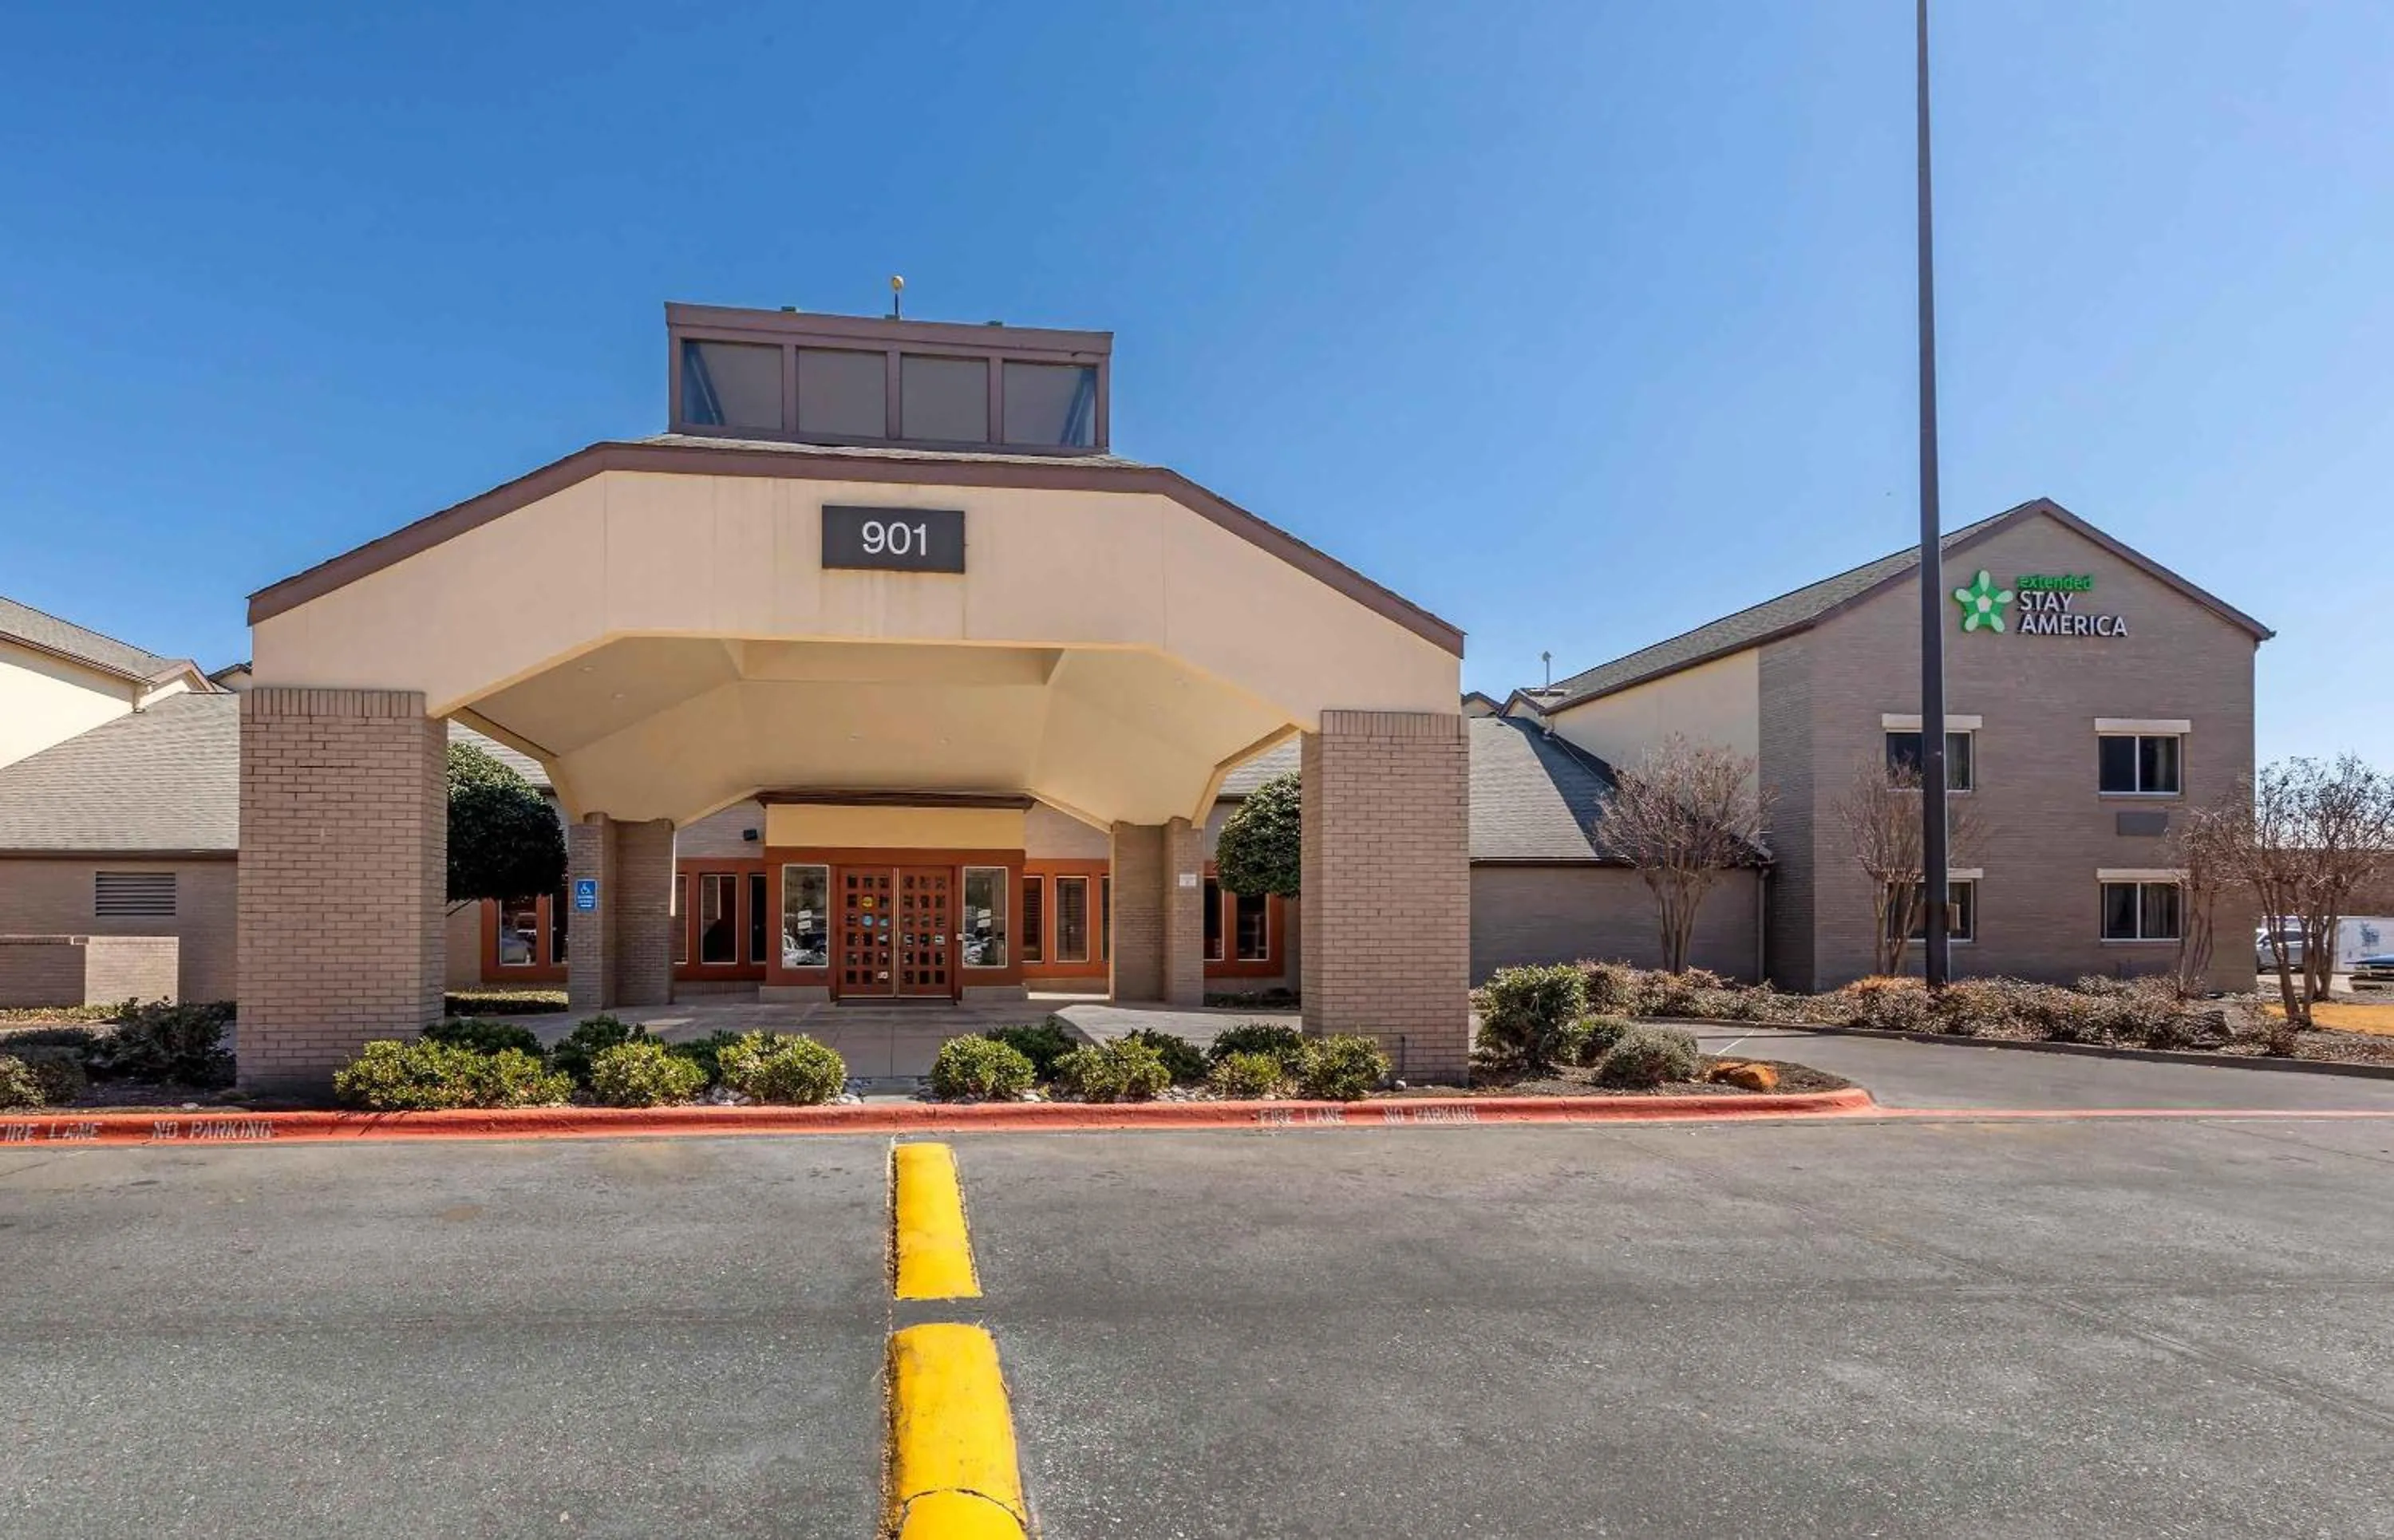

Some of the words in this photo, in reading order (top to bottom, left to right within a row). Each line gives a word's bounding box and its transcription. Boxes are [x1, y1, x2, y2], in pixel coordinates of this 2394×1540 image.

[862, 521, 926, 556] 901
[2018, 575, 2092, 590] extended
[2019, 590, 2074, 611] STAY
[2020, 614, 2128, 636] AMERICA
[1259, 1107, 1295, 1126] FIRE
[1303, 1107, 1346, 1125] LANE
[1384, 1105, 1404, 1123] NO
[1413, 1104, 1479, 1124] PARKING
[48, 1123, 102, 1140] LANE
[152, 1120, 179, 1139] NO
[188, 1119, 273, 1139] PARKING
